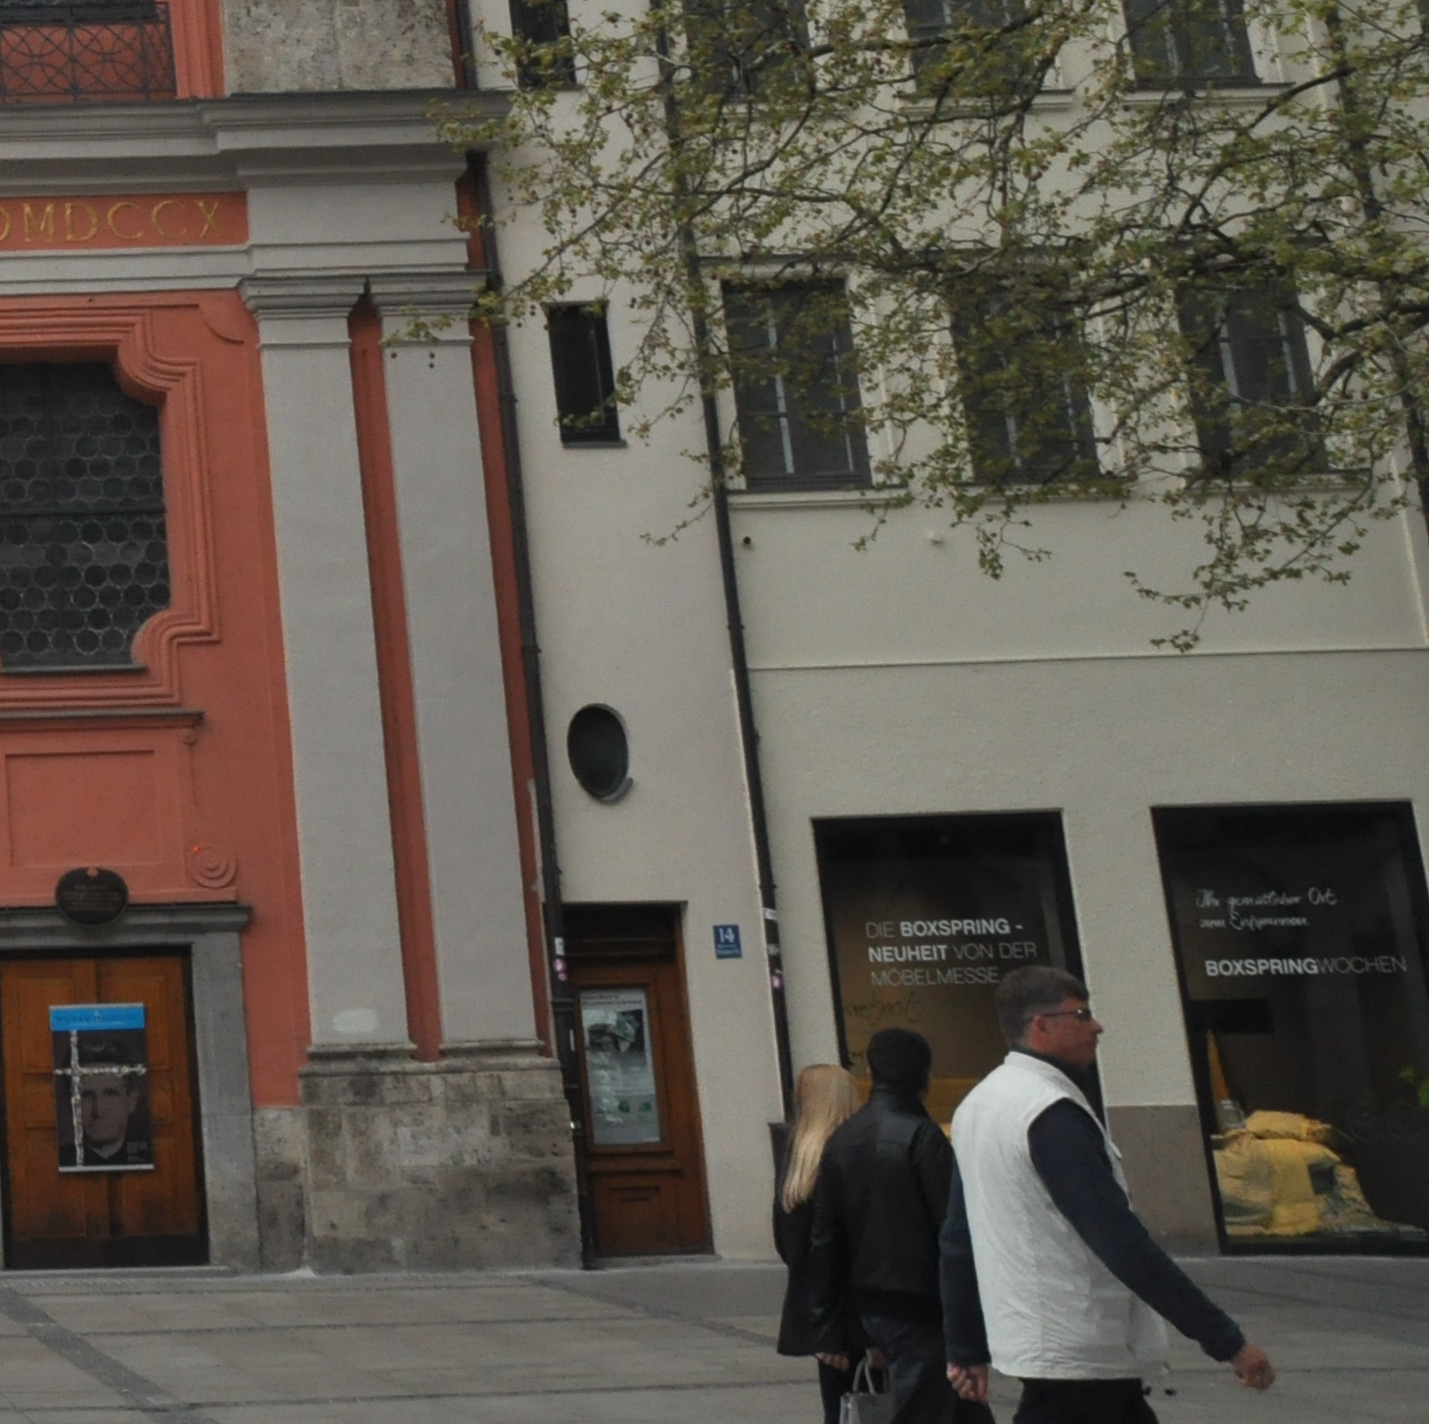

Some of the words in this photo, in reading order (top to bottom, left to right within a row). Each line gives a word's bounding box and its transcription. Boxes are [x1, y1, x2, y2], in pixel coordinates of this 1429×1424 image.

[718, 927, 735, 943] 14
[866, 921, 895, 939] DIE
[900, 918, 1010, 938] BOXSPRING
[868, 945, 948, 963] NEUHEIT
[953, 943, 993, 961] VON
[999, 941, 1038, 959] DER
